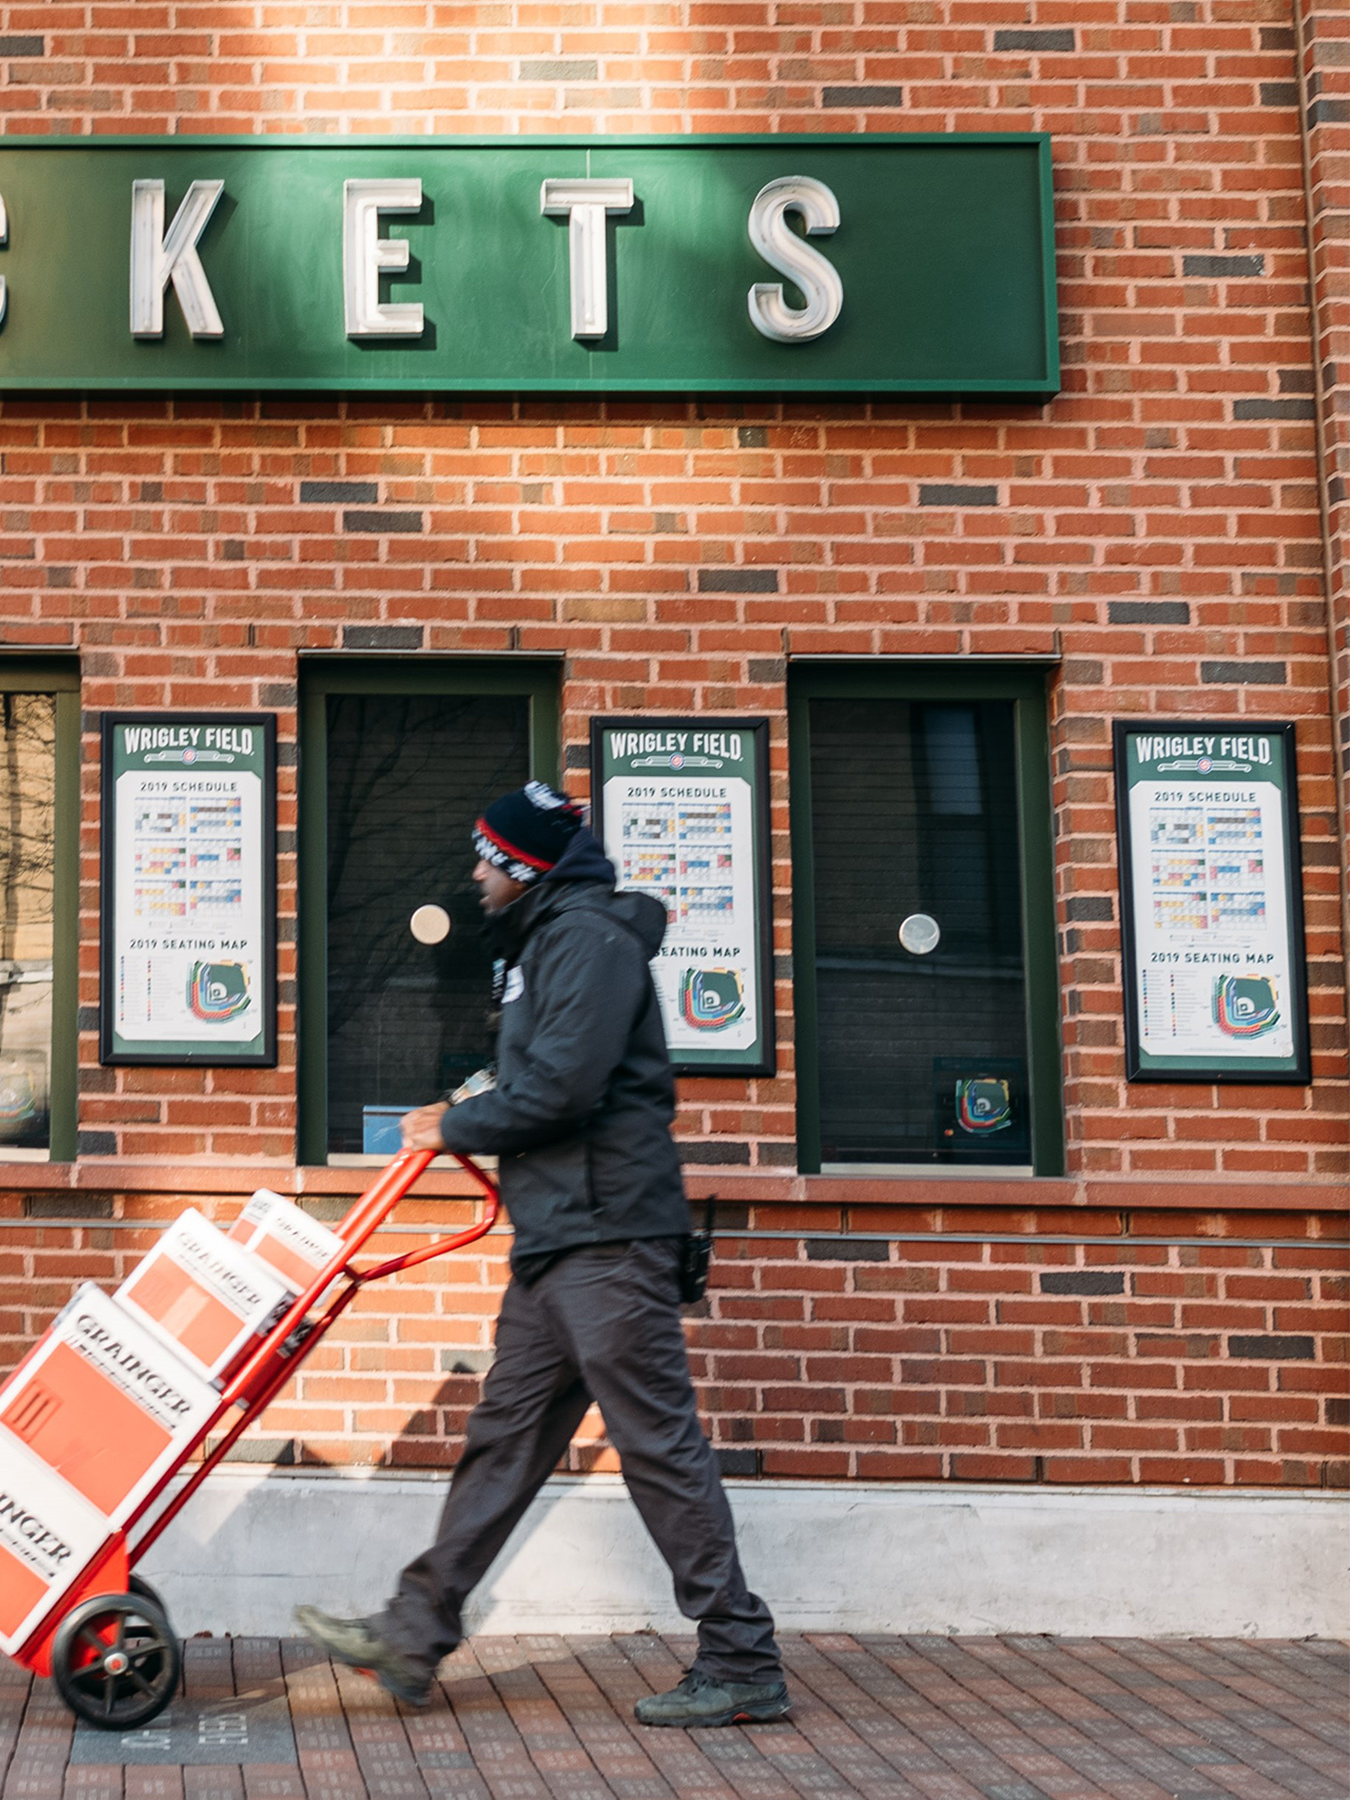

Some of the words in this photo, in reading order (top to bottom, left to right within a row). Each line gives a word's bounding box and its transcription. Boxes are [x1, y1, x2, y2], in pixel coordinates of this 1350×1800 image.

[124, 727, 201, 755] WRIGLEY
[205, 727, 252, 755] FIELD
[610, 732, 688, 760] WRIGLEY
[693, 733, 742, 761] FIELD
[1136, 736, 1216, 765] WRIGLEY
[1220, 737, 1270, 765] FIELD
[140, 782, 168, 792] 2019
[173, 782, 238, 792] SCHEDULE
[627, 787, 656, 798] 2019
[660, 787, 727, 798] SCHEDULE
[1155, 791, 1184, 802] 2019
[1188, 791, 1257, 803] SCHEDULE
[130, 939, 157, 950] 2019
[162, 939, 216, 950] SEATING
[221, 939, 248, 950] MAP
[713, 946, 741, 957] MAP
[1150, 952, 1179, 963] 2019
[1184, 952, 1240, 964] SEATING
[1246, 953, 1274, 964] MAP
[76, 1314, 191, 1417] GRAINGER
